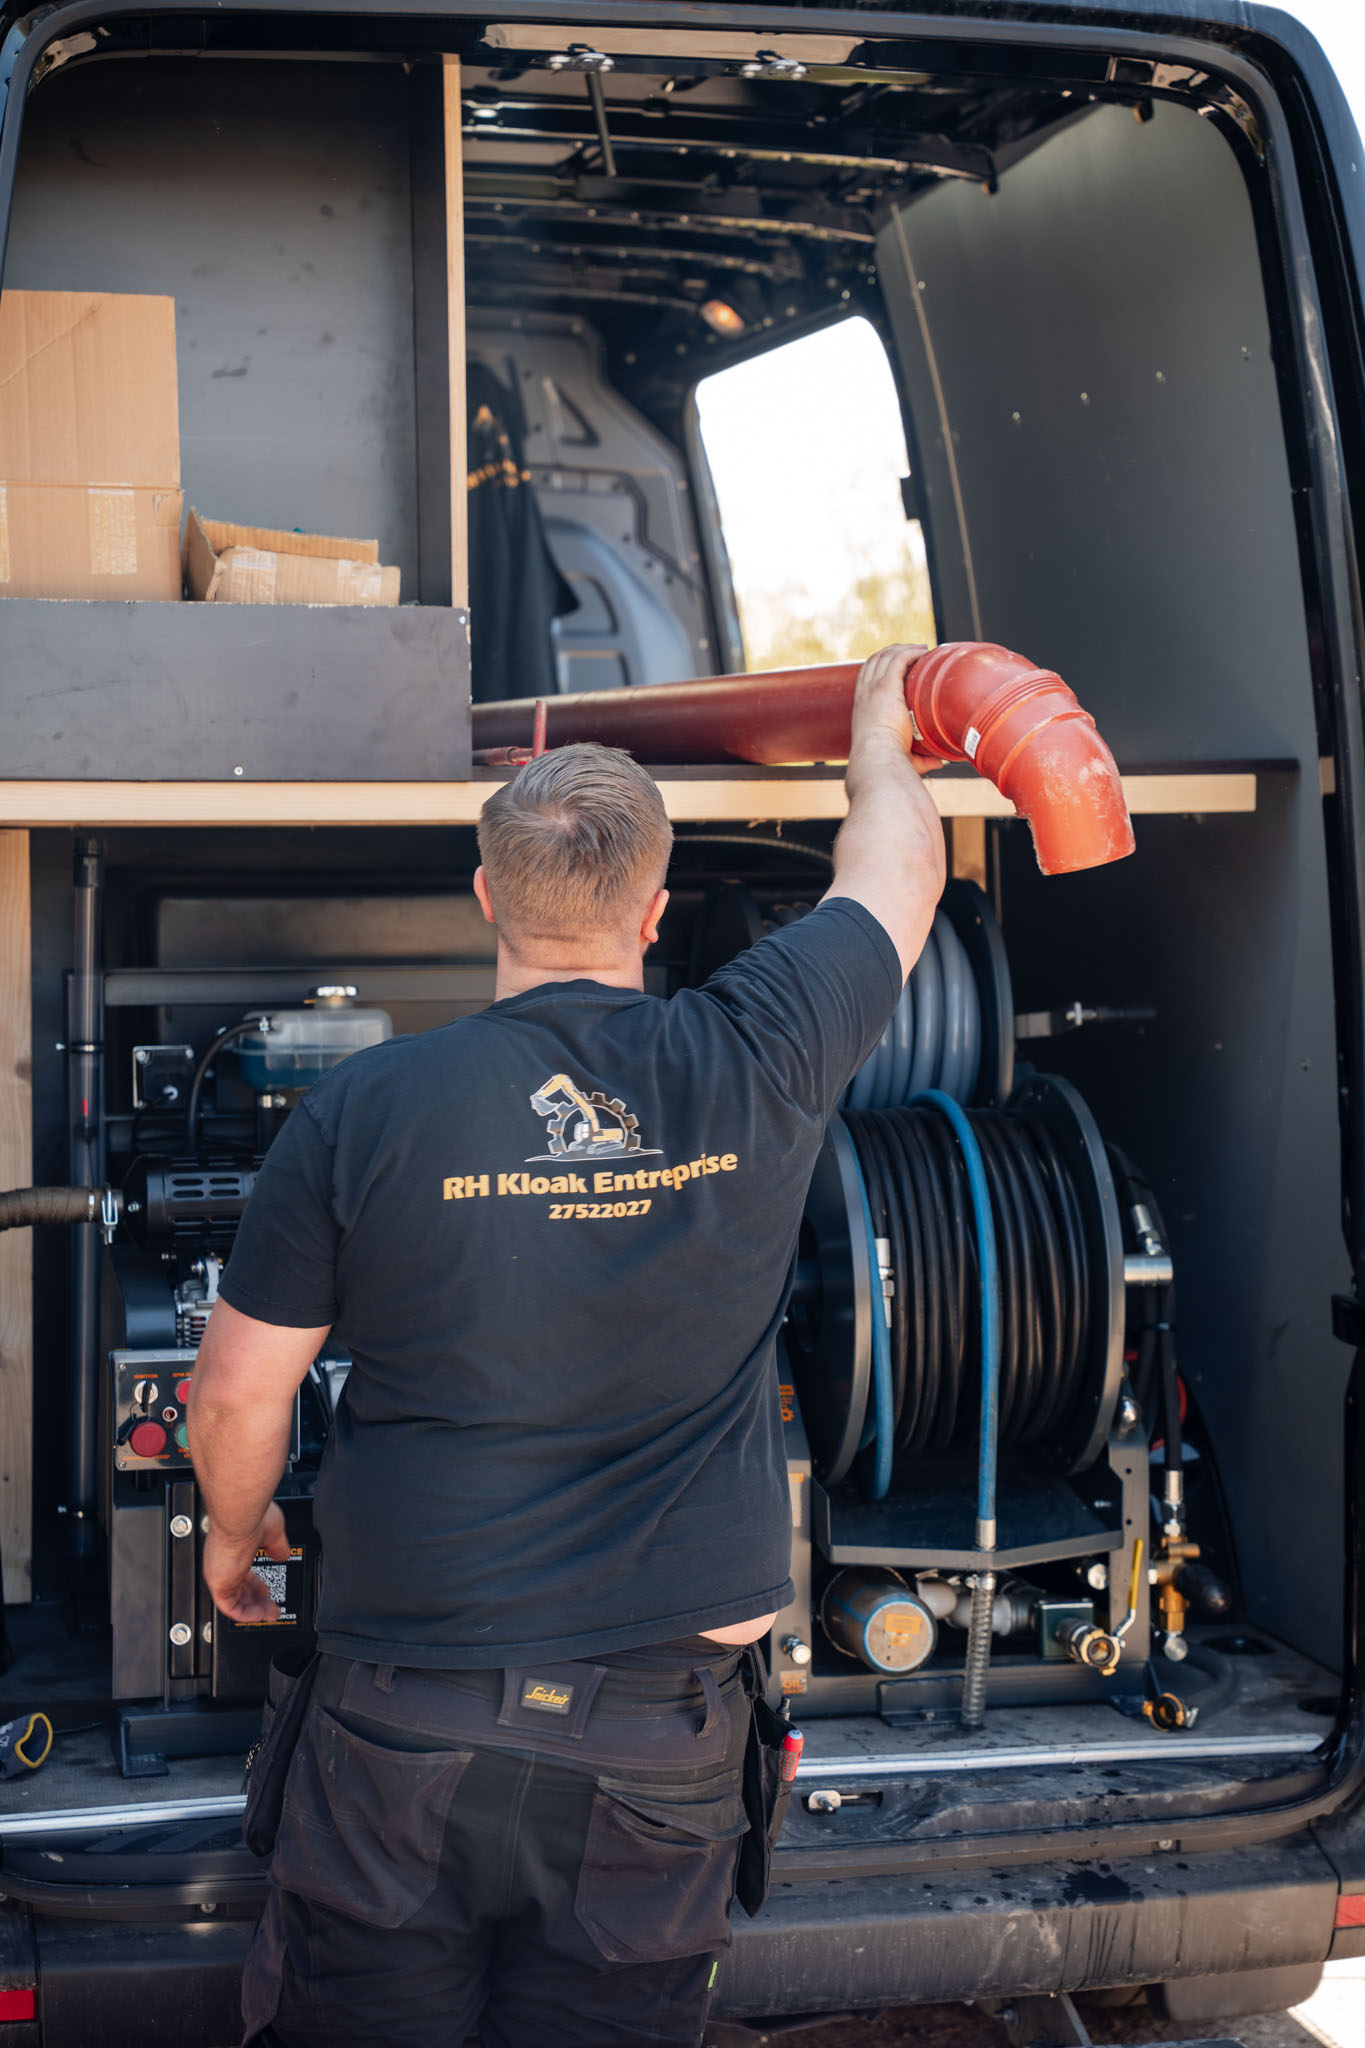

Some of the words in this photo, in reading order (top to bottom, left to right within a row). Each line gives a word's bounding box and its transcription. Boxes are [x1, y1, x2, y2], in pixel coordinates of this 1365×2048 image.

[443, 1174, 490, 1200] RH
[497, 1172, 588, 1196] Kloak
[593, 1153, 738, 1191] Entreprise
[548, 1199, 652, 1220] 27522027
